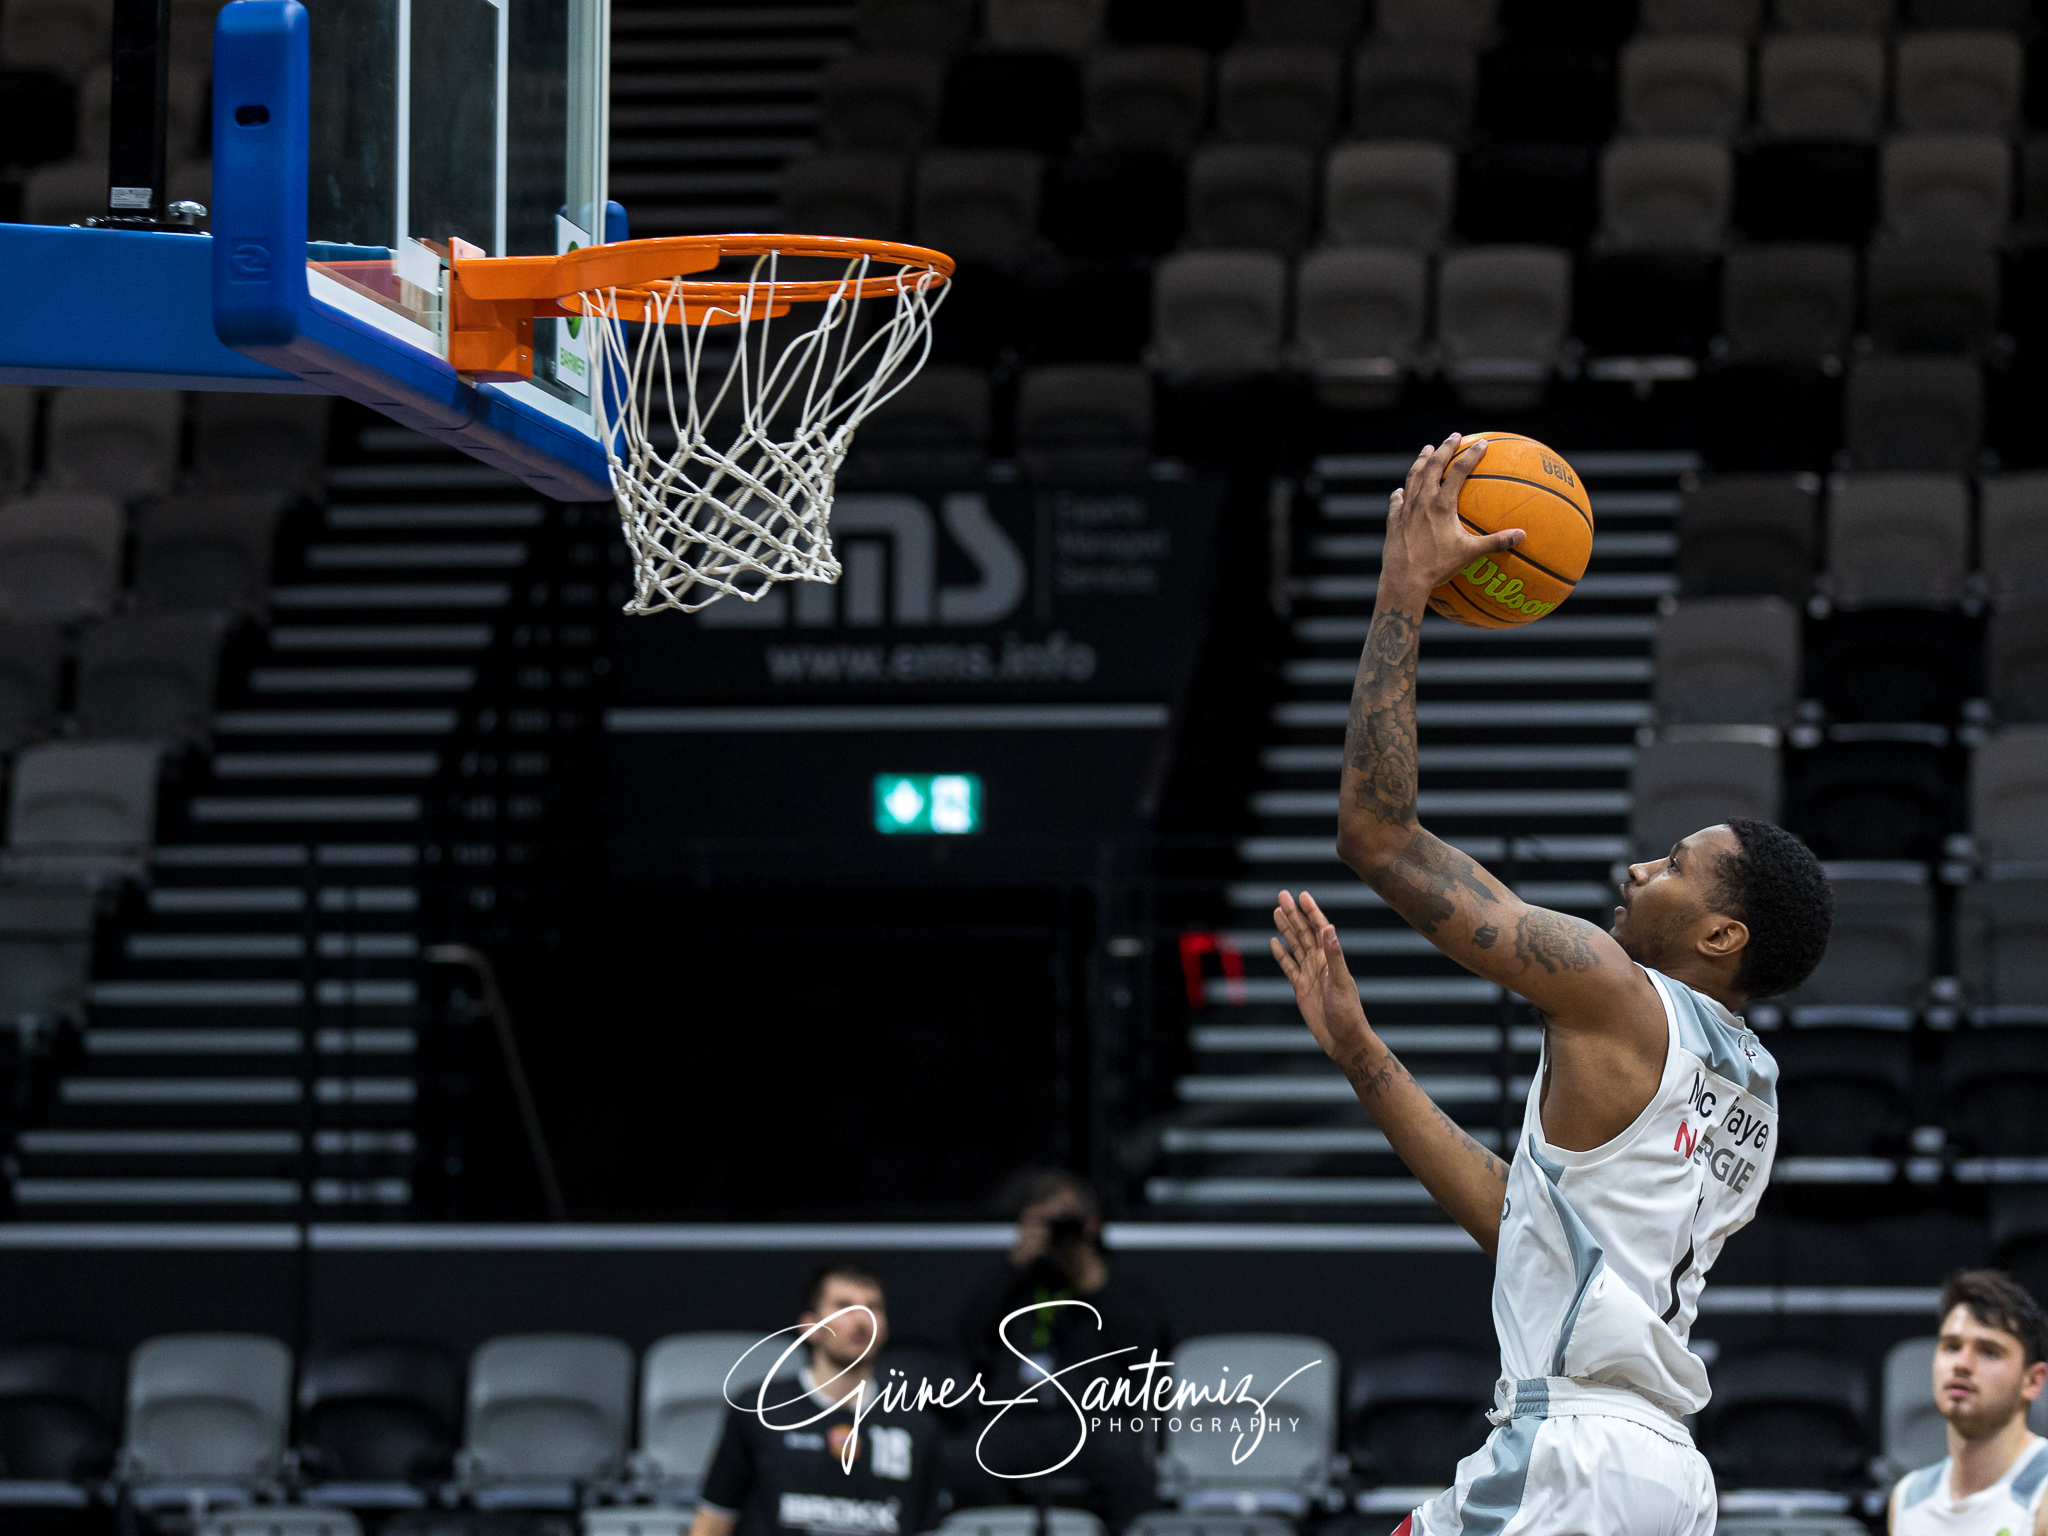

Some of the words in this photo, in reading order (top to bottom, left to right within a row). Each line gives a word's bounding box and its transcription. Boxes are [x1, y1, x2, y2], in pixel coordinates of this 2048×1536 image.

[559, 346, 586, 378] BARMER
[1460, 556, 1557, 616] Wilson
[765, 631, 1097, 683] www.ems.info
